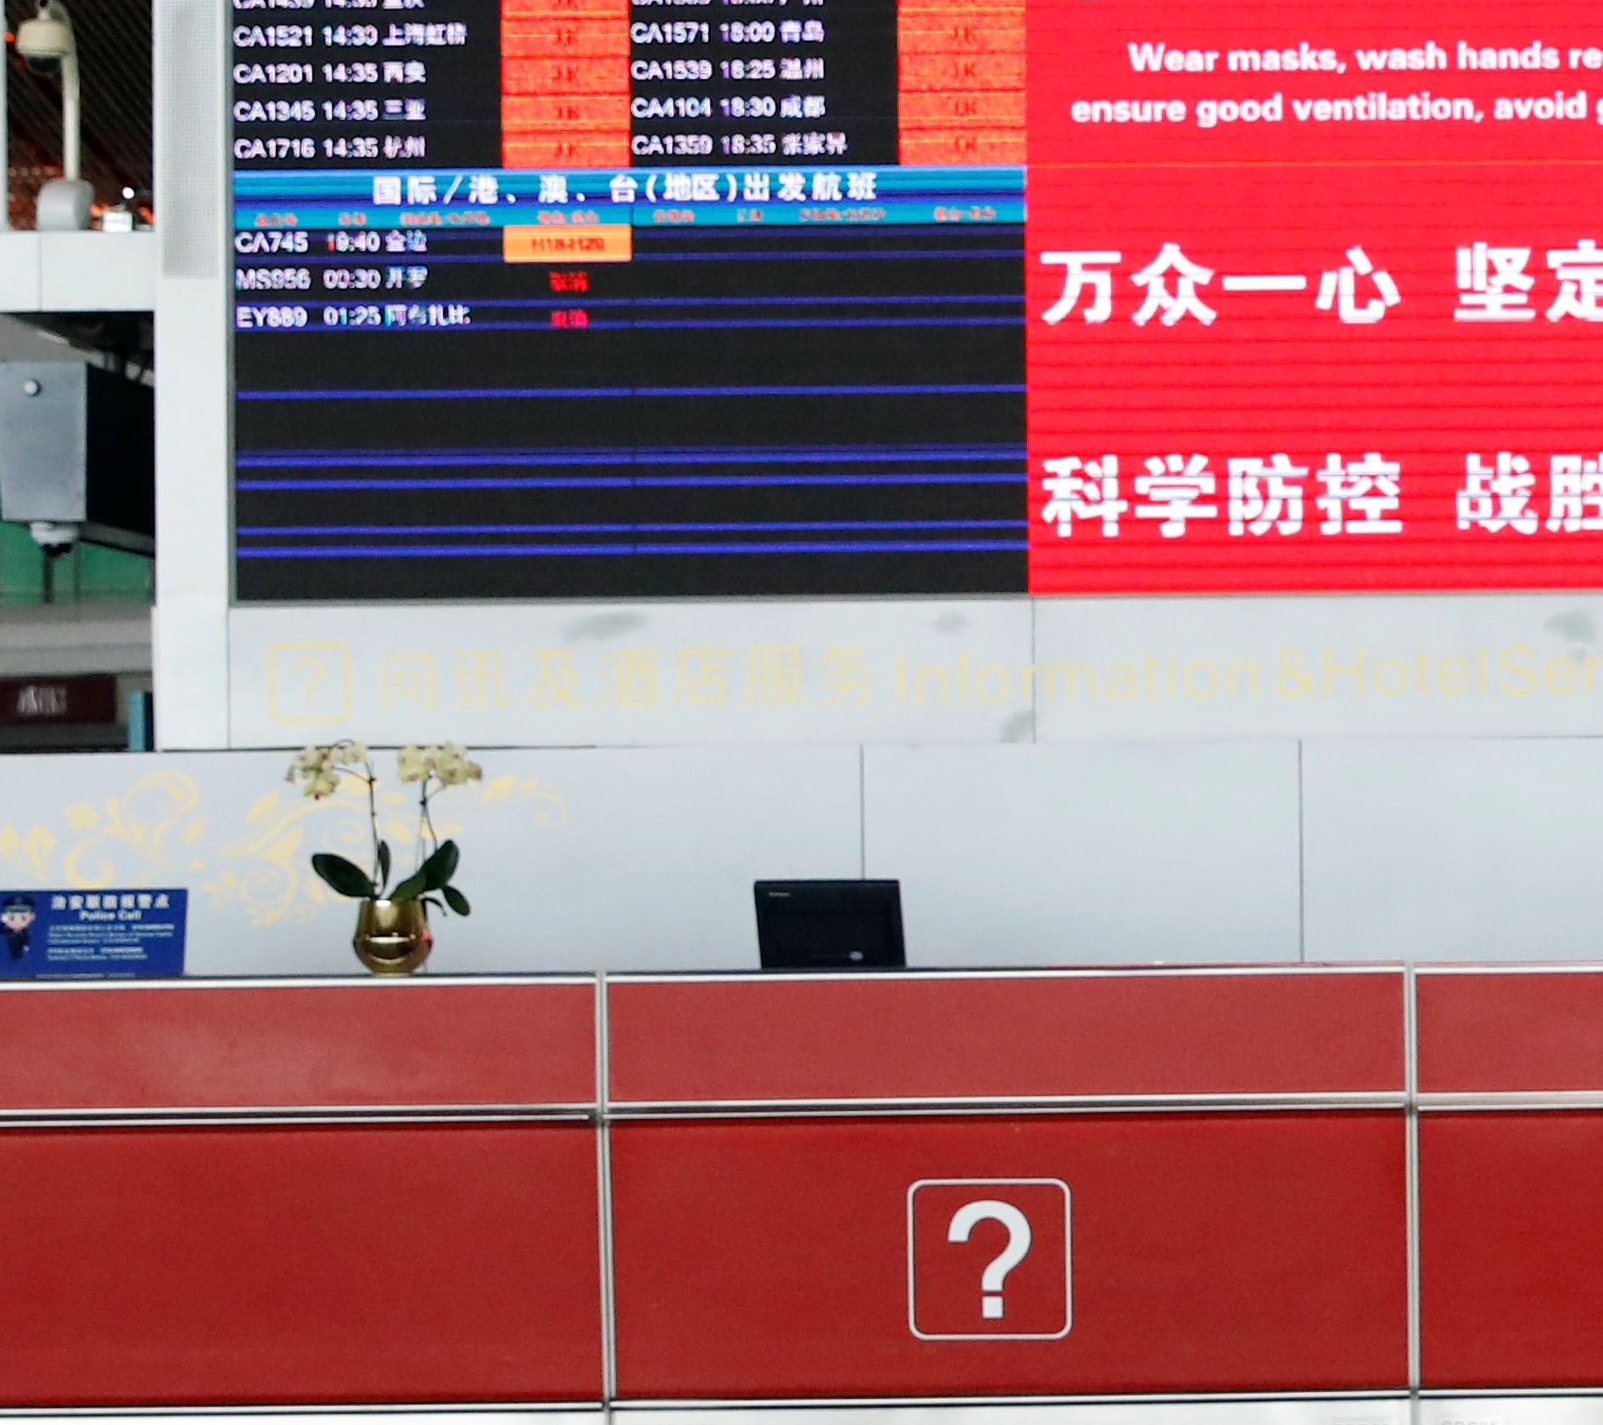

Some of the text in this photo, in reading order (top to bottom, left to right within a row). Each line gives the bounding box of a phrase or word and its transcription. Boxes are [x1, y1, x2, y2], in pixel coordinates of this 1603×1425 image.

[230, 26, 312, 47] CA1521
[323, 25, 377, 46] 14:30
[630, 22, 709, 43] CA1571
[720, 21, 774, 42] 18:00
[1128, 42, 1219, 72] Wear
[1227, 40, 1346, 75] masks,
[1355, 40, 1447, 70] wash
[1457, 40, 1560, 69] hands
[230, 64, 312, 85] CA1201
[323, 63, 378, 82] 14:35
[721, 60, 774, 79] 18:25
[230, 100, 315, 121] CA1345
[323, 100, 378, 120] 14:35
[384, 100, 426, 120] 三亚
[720, 96, 774, 117] 18:30
[1071, 100, 1186, 123] ensure
[1196, 92, 1283, 128] good
[1292, 91, 1484, 124] ventilation,
[1494, 90, 1587, 120] avoid
[230, 136, 315, 160] CA1716
[324, 138, 378, 157] 14:35
[721, 134, 774, 154] 18:35
[235, 232, 308, 253] CA745
[328, 232, 380, 251] 19:40
[235, 268, 311, 289] MS956
[324, 269, 380, 288] 00:30
[1040, 242, 1401, 326] 万众一心
[235, 305, 307, 327] EY889
[324, 306, 381, 326] 01:25
[1041, 452, 1403, 538] 科学防控
[379, 643, 875, 711] 问讯及酒店服务
[895, 653, 1260, 705] Information
[79, 910, 116, 921] Police
